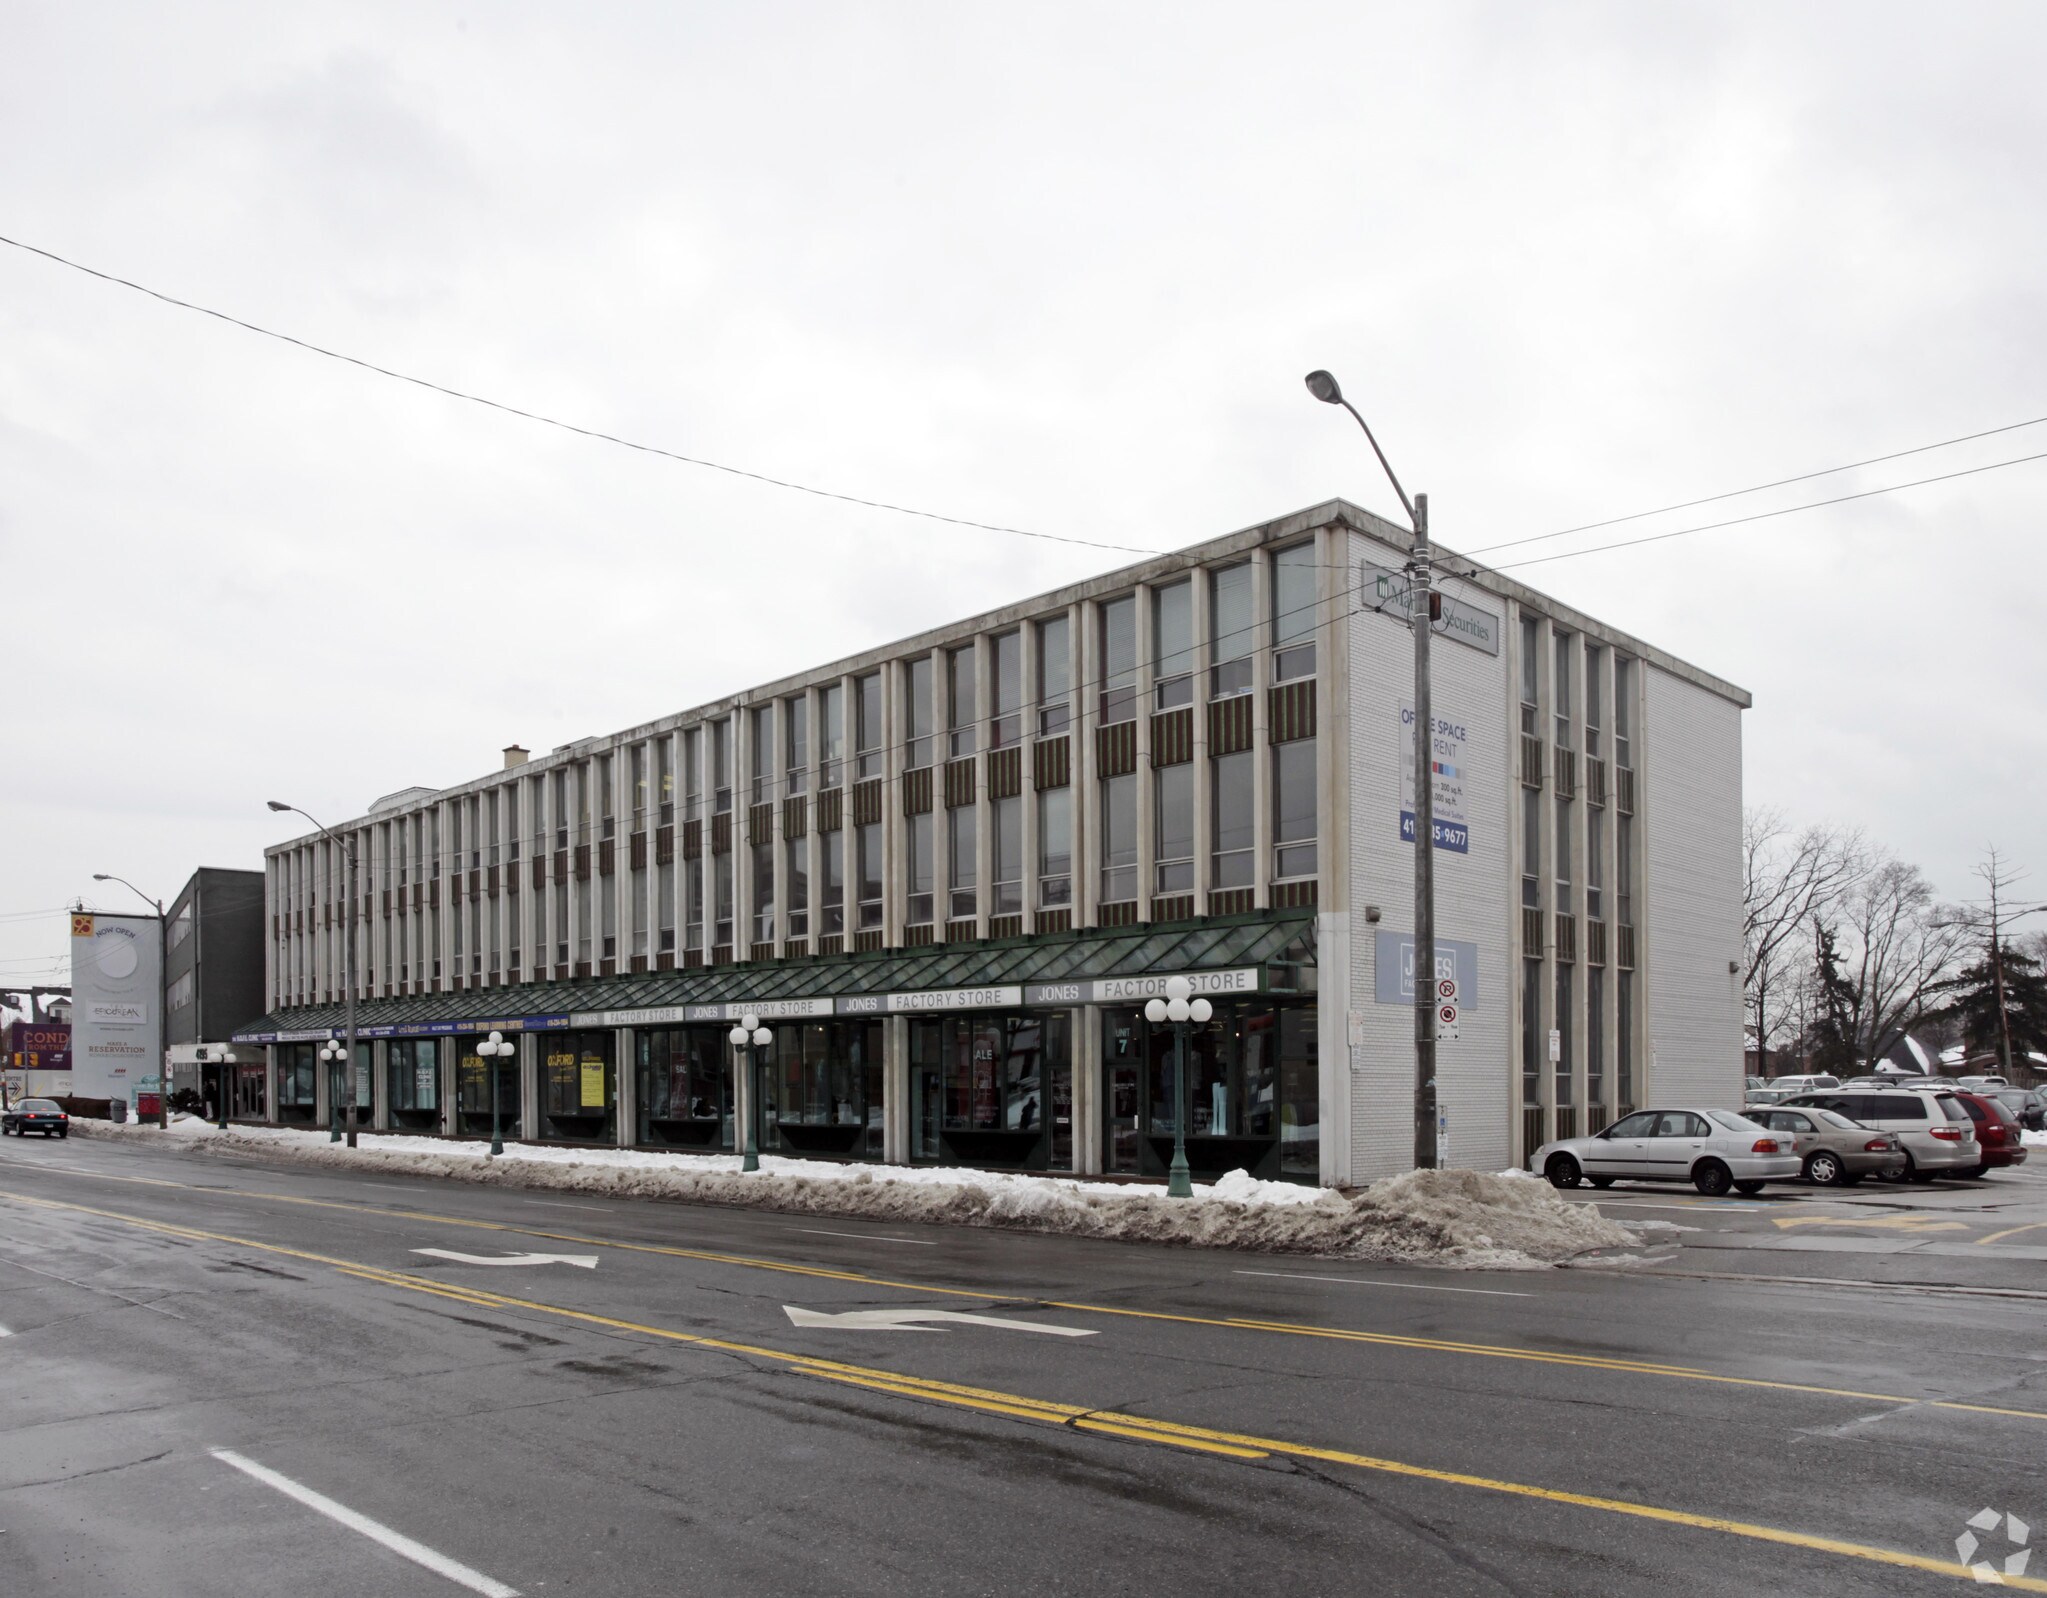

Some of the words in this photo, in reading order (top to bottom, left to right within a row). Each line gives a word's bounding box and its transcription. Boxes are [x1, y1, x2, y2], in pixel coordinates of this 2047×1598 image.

[1442, 606, 1490, 642] Securities
[1401, 708, 1435, 733] OFE
[1437, 719, 1466, 742] SPACE
[1433, 738, 1457, 758] RENT
[95, 926, 114, 938] NOW
[115, 927, 136, 939] OPEN
[1404, 953, 1453, 980] JES
[1038, 984, 1079, 1001] JONES
[1104, 978, 1167, 997] FACTOR
[1188, 973, 1245, 992] STORE
[846, 997, 878, 1012] JONES
[896, 993, 952, 1009] FACTORY
[958, 990, 1002, 1006] STORE
[610, 1011, 647, 1023] FACTORY
[648, 1009, 677, 1021] STORE
[693, 1006, 718, 1019] JONES
[732, 1003, 776, 1017] FACTORY
[780, 1001, 814, 1015] STORE
[576, 1014, 598, 1025] JONES
[1114, 1027, 1131, 1038] UNIT
[88, 1046, 146, 1054] RESERVATION
[1118, 1039, 1128, 1054] 7
[973, 1049, 993, 1060] ALE
[675, 1064, 688, 1074] SAL
